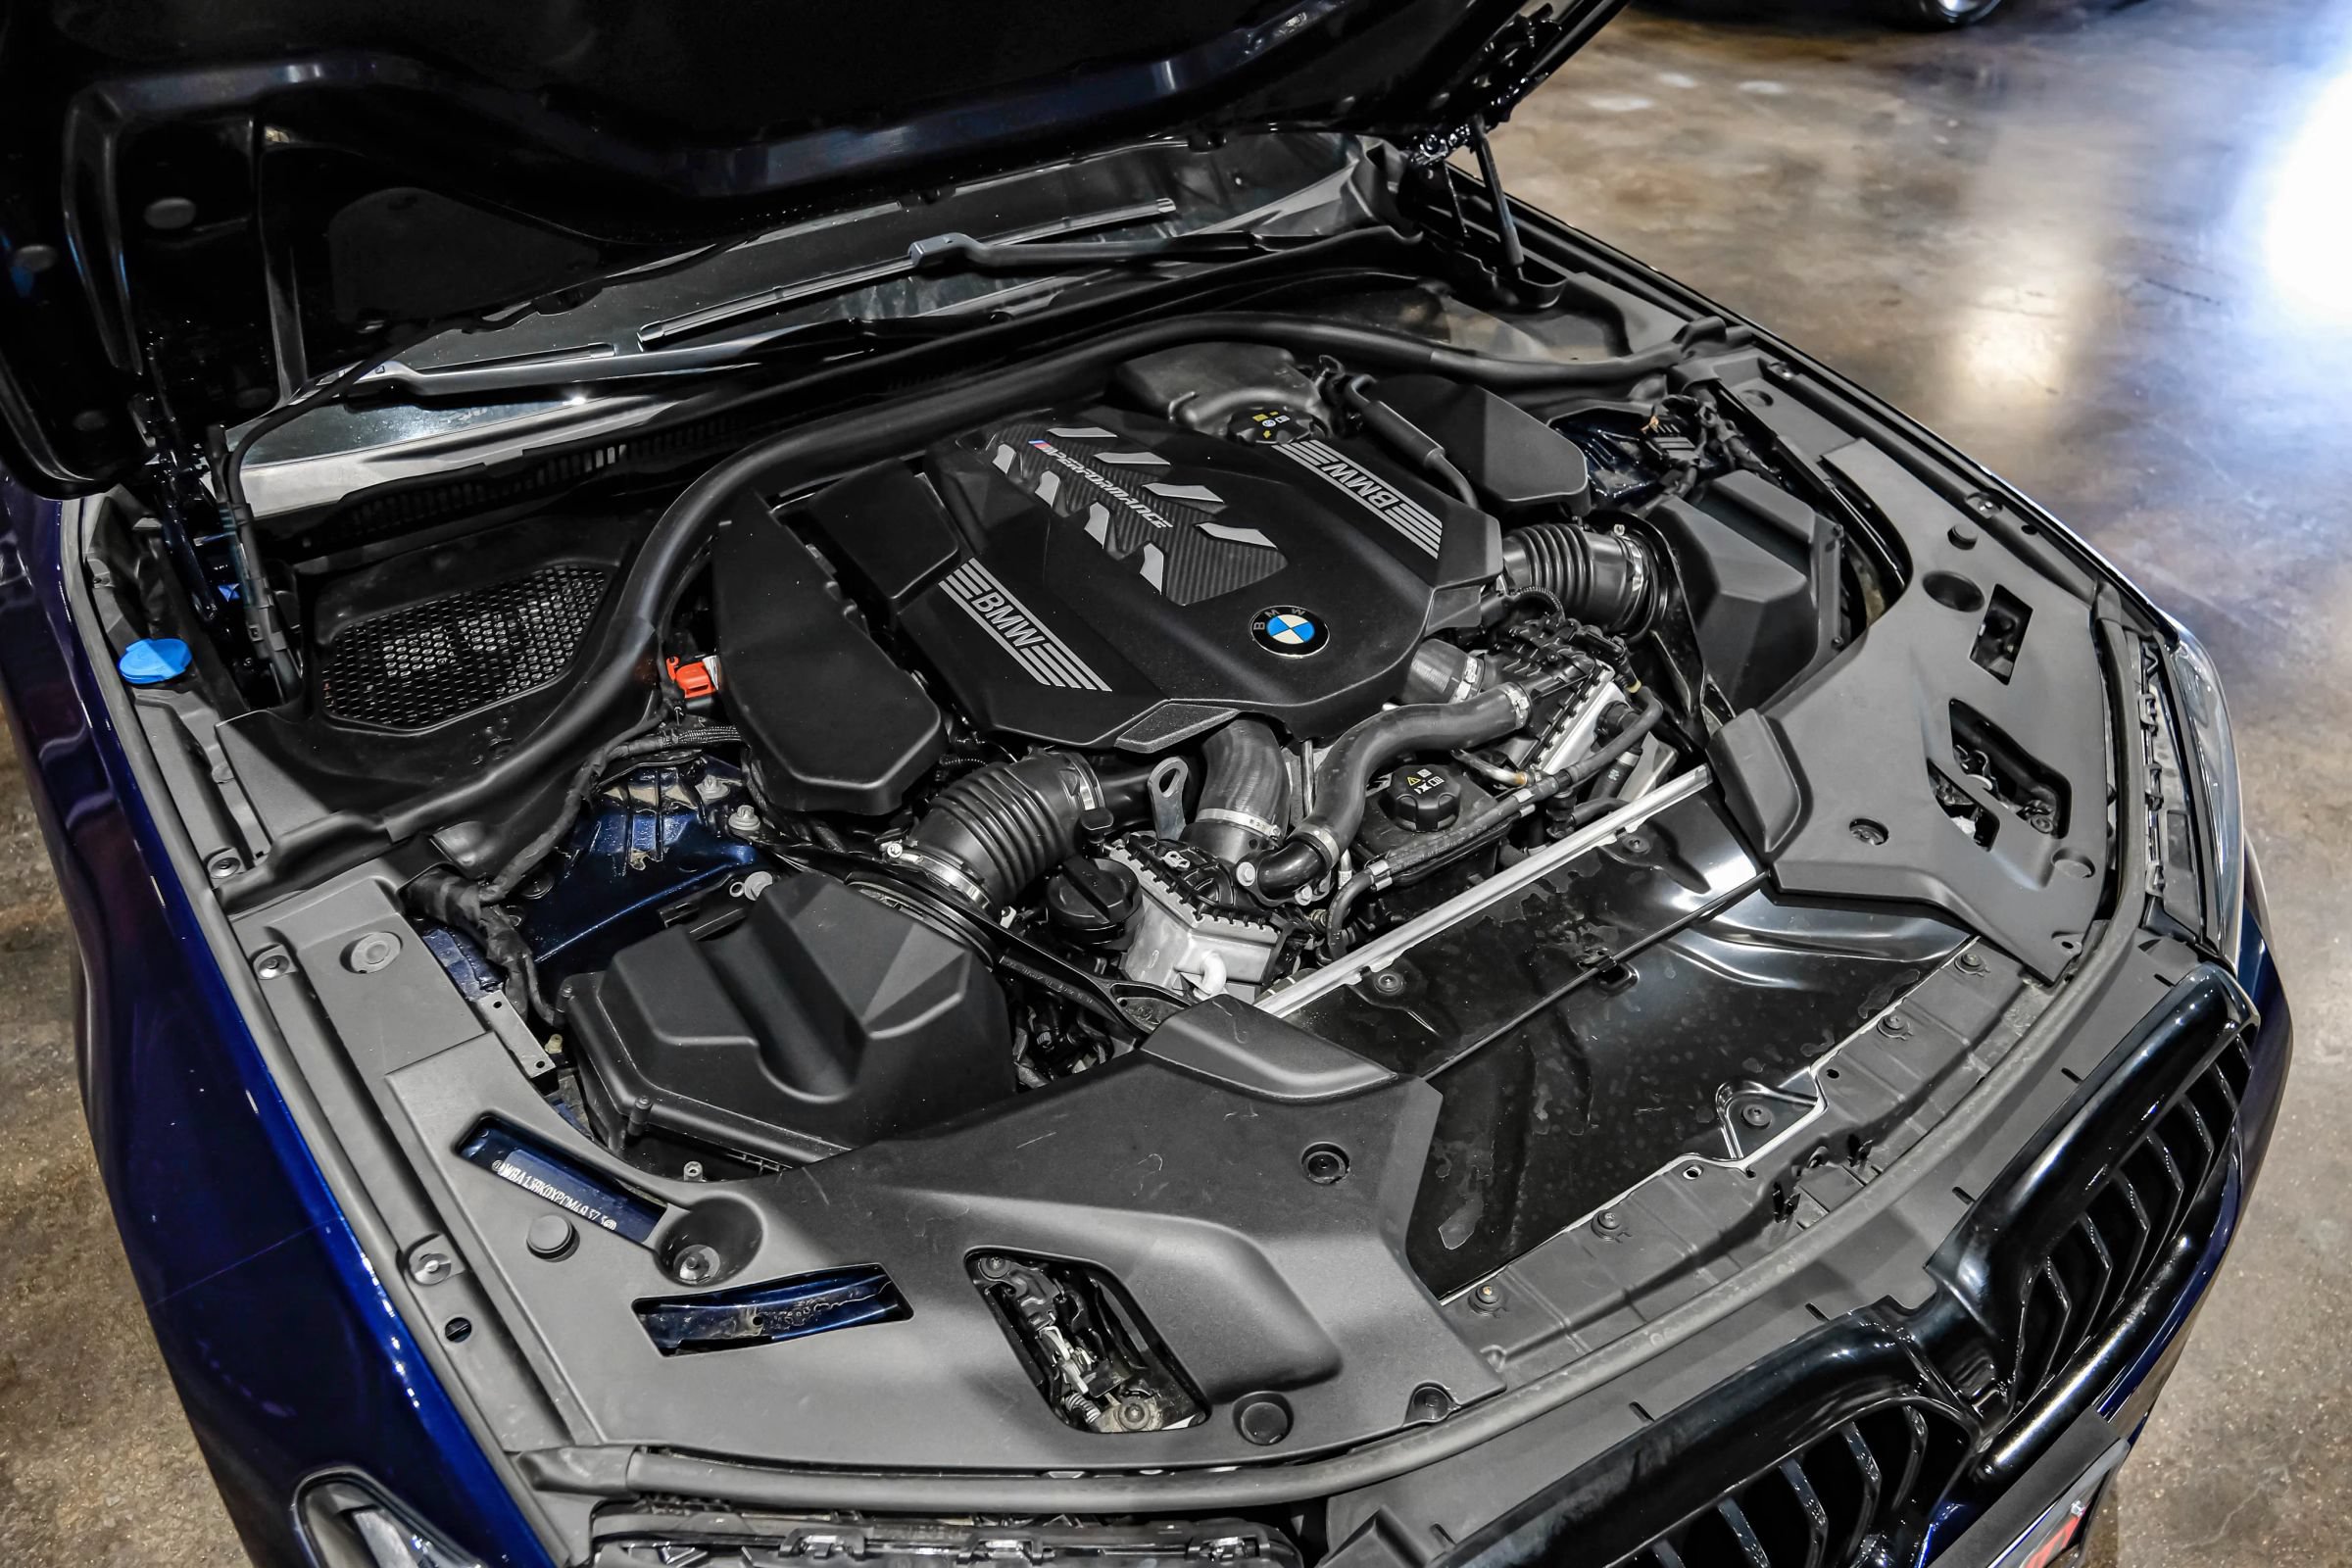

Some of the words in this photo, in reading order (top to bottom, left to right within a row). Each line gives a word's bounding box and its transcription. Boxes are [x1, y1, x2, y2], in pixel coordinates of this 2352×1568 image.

[1049, 451, 1174, 529] PERFORMANCE
[1320, 463, 1400, 510] BMW
[970, 591, 1046, 647] BMW
[1253, 608, 1305, 630] BMW
